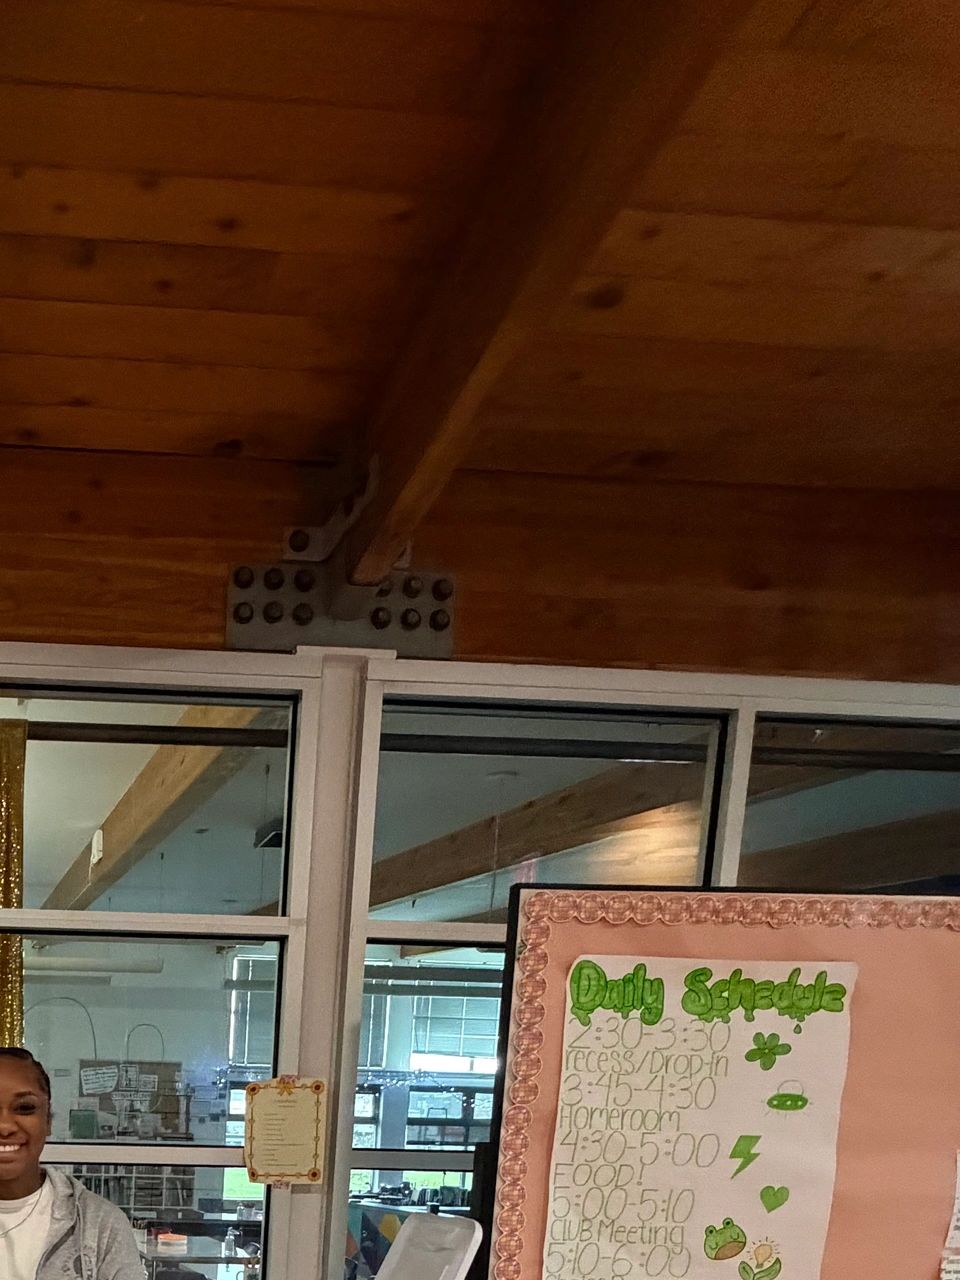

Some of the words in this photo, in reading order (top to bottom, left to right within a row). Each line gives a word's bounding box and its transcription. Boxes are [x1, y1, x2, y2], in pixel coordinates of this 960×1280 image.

[570, 959, 664, 1026] Daily
[682, 967, 846, 1023] Schedule
[568, 1017, 731, 1052] 2:30-3:30
[563, 1073, 716, 1110] 3:45-4:30
[560, 1106, 681, 1132] Homeroom
[559, 1132, 721, 1168] 4:30-5:00
[554, 1164, 644, 1187] FOOD!
[552, 1186, 695, 1224] 5:00-5:10
[598, 1220, 685, 1254] Meeting
[545, 1242, 692, 1277] 5:10-6:00
